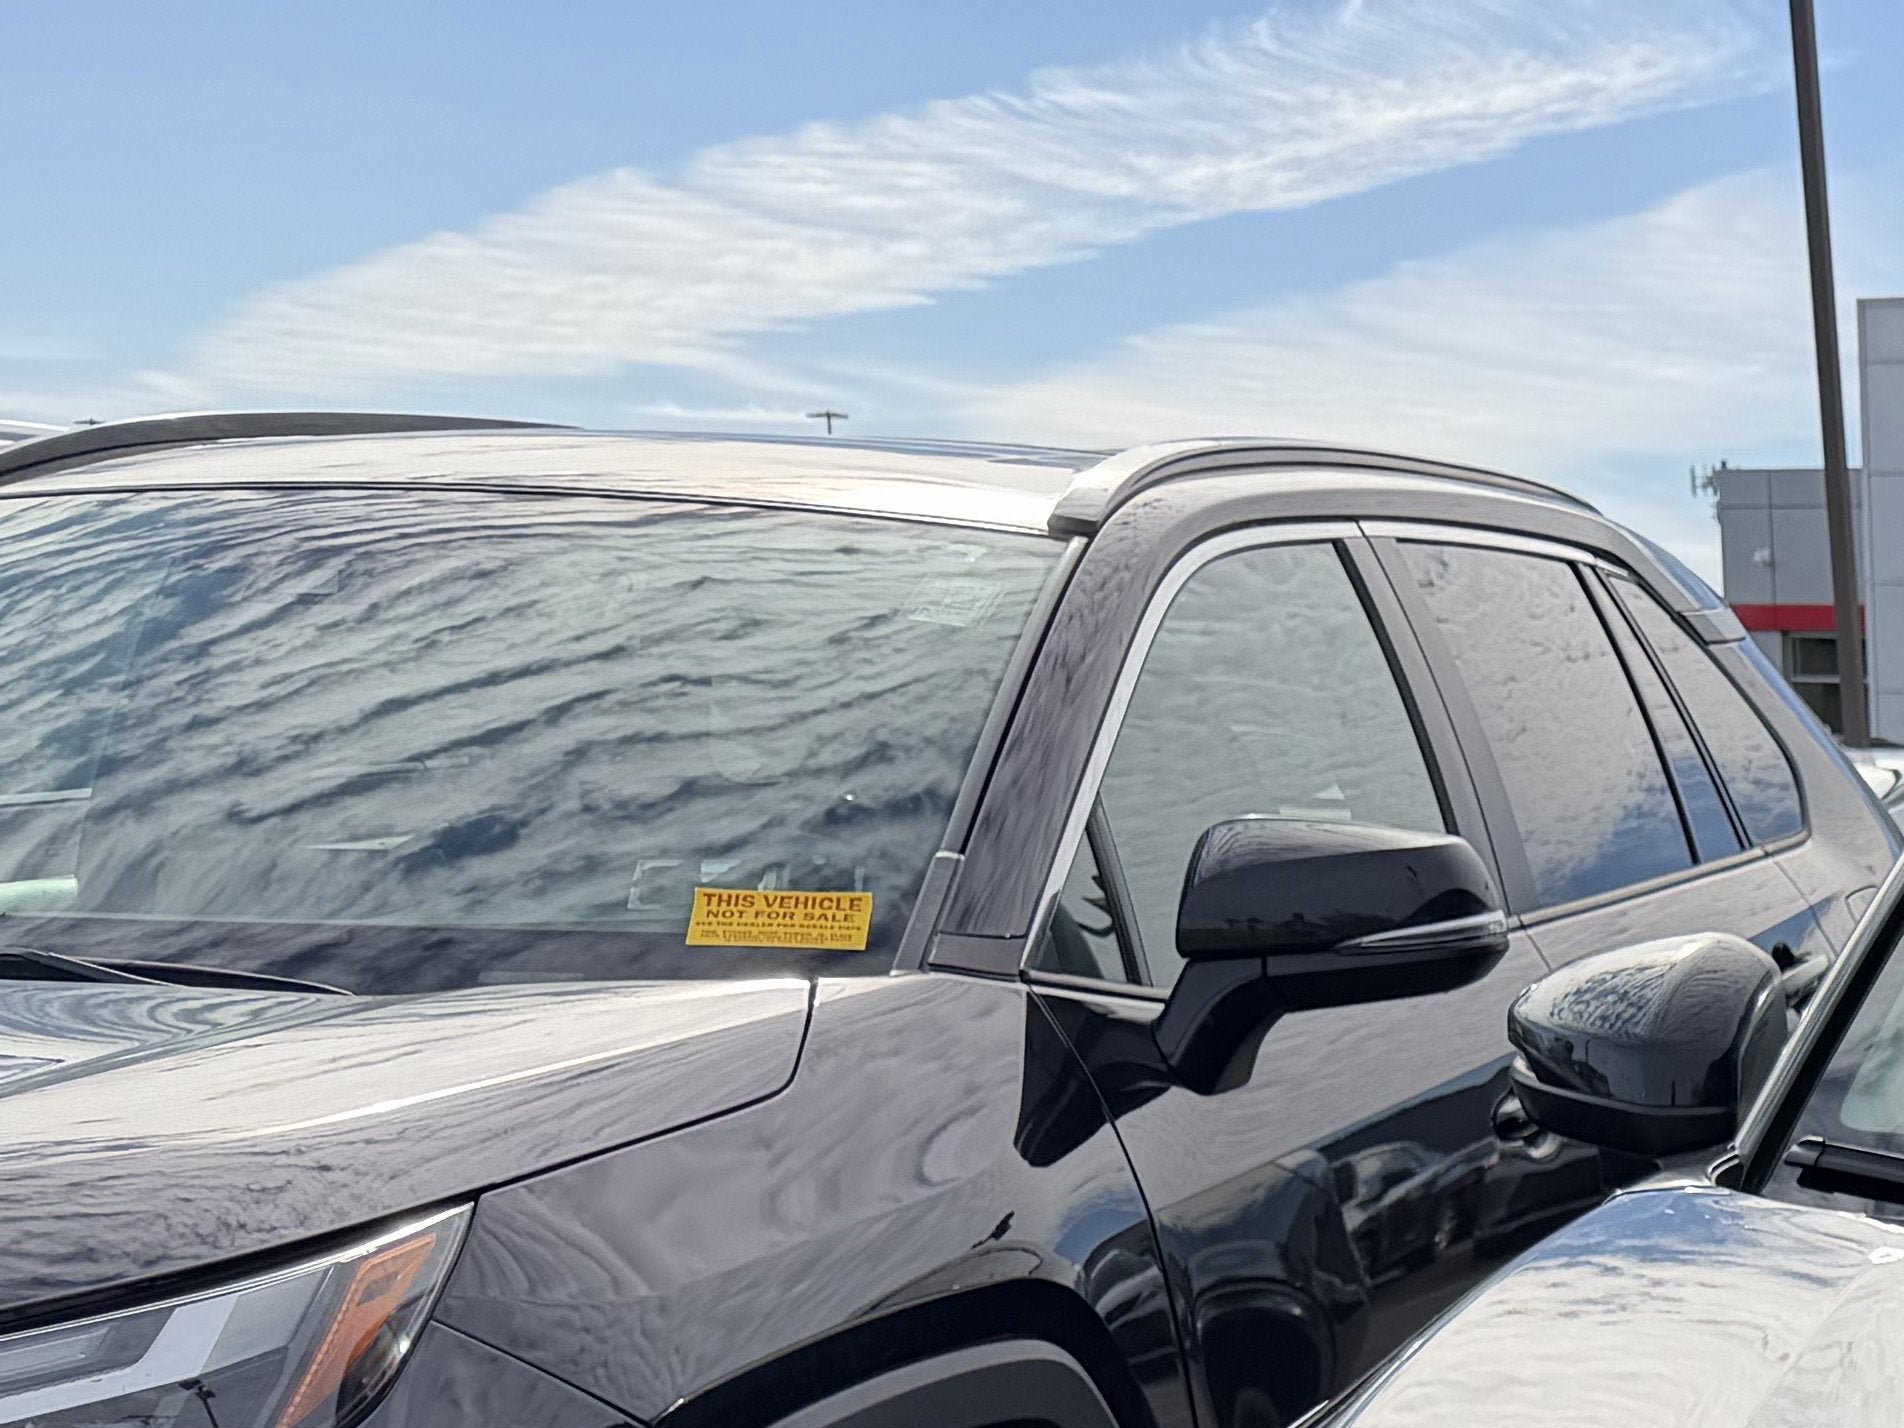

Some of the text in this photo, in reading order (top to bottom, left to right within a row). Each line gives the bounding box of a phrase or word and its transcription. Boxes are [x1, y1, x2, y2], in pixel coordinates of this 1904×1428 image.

[703, 893, 863, 912] THIS VEHICLE
[706, 909, 856, 923] NOT FOR SALE
